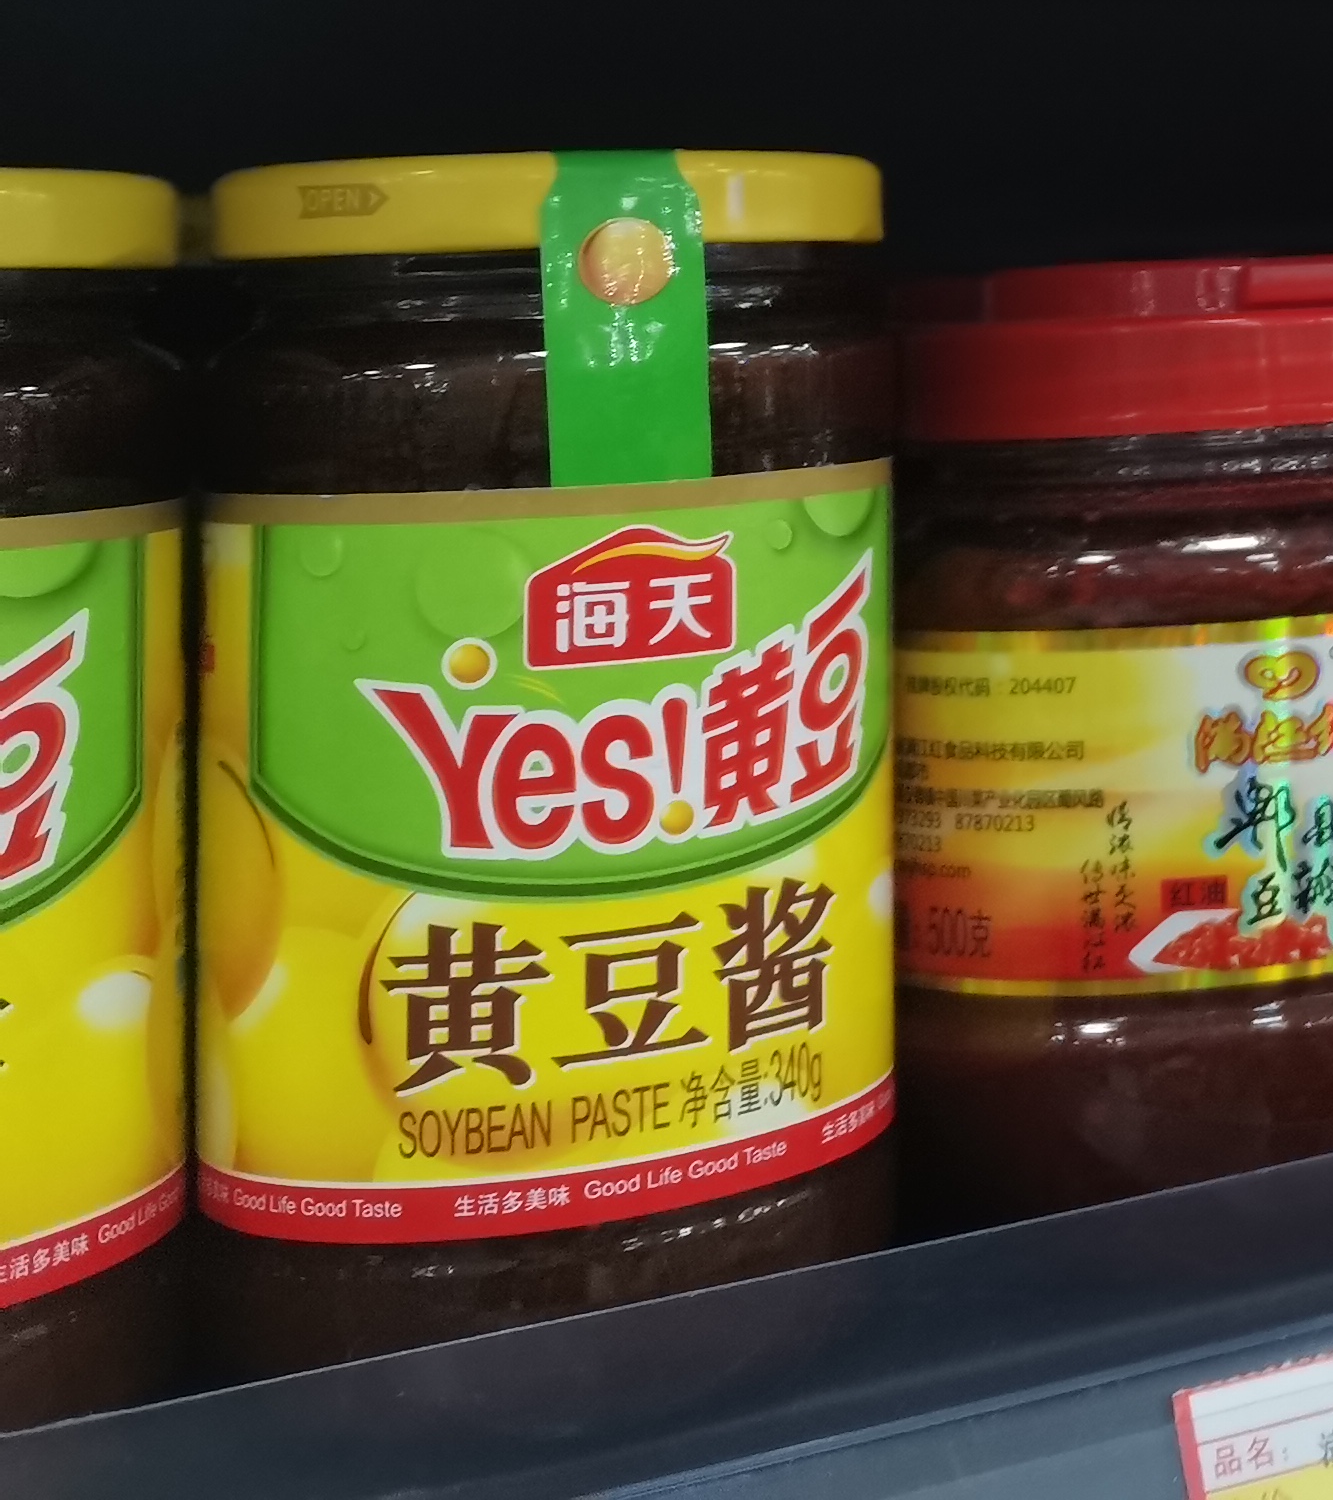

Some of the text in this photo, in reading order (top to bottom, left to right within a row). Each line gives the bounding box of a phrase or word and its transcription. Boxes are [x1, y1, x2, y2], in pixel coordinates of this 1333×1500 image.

[308, 188, 360, 211] OPEN
[555, 572, 714, 653] 海天
[362, 558, 870, 856] Yes!黄豆
[1009, 676, 1077, 695] 204407
[955, 812, 1035, 832] 87870213
[380, 877, 837, 1098] 黄豆酱
[398, 1099, 553, 1160] SOYBEAN
[571, 1080, 672, 1145] PASTE
[232, 1187, 267, 1211] Good
[269, 1191, 297, 1215] Life
[301, 1197, 347, 1218] Good
[352, 1199, 403, 1218] Taste
[453, 1139, 787, 1219] 生活多美味 Good Life Good Taste
[97, 1214, 136, 1245] Good
